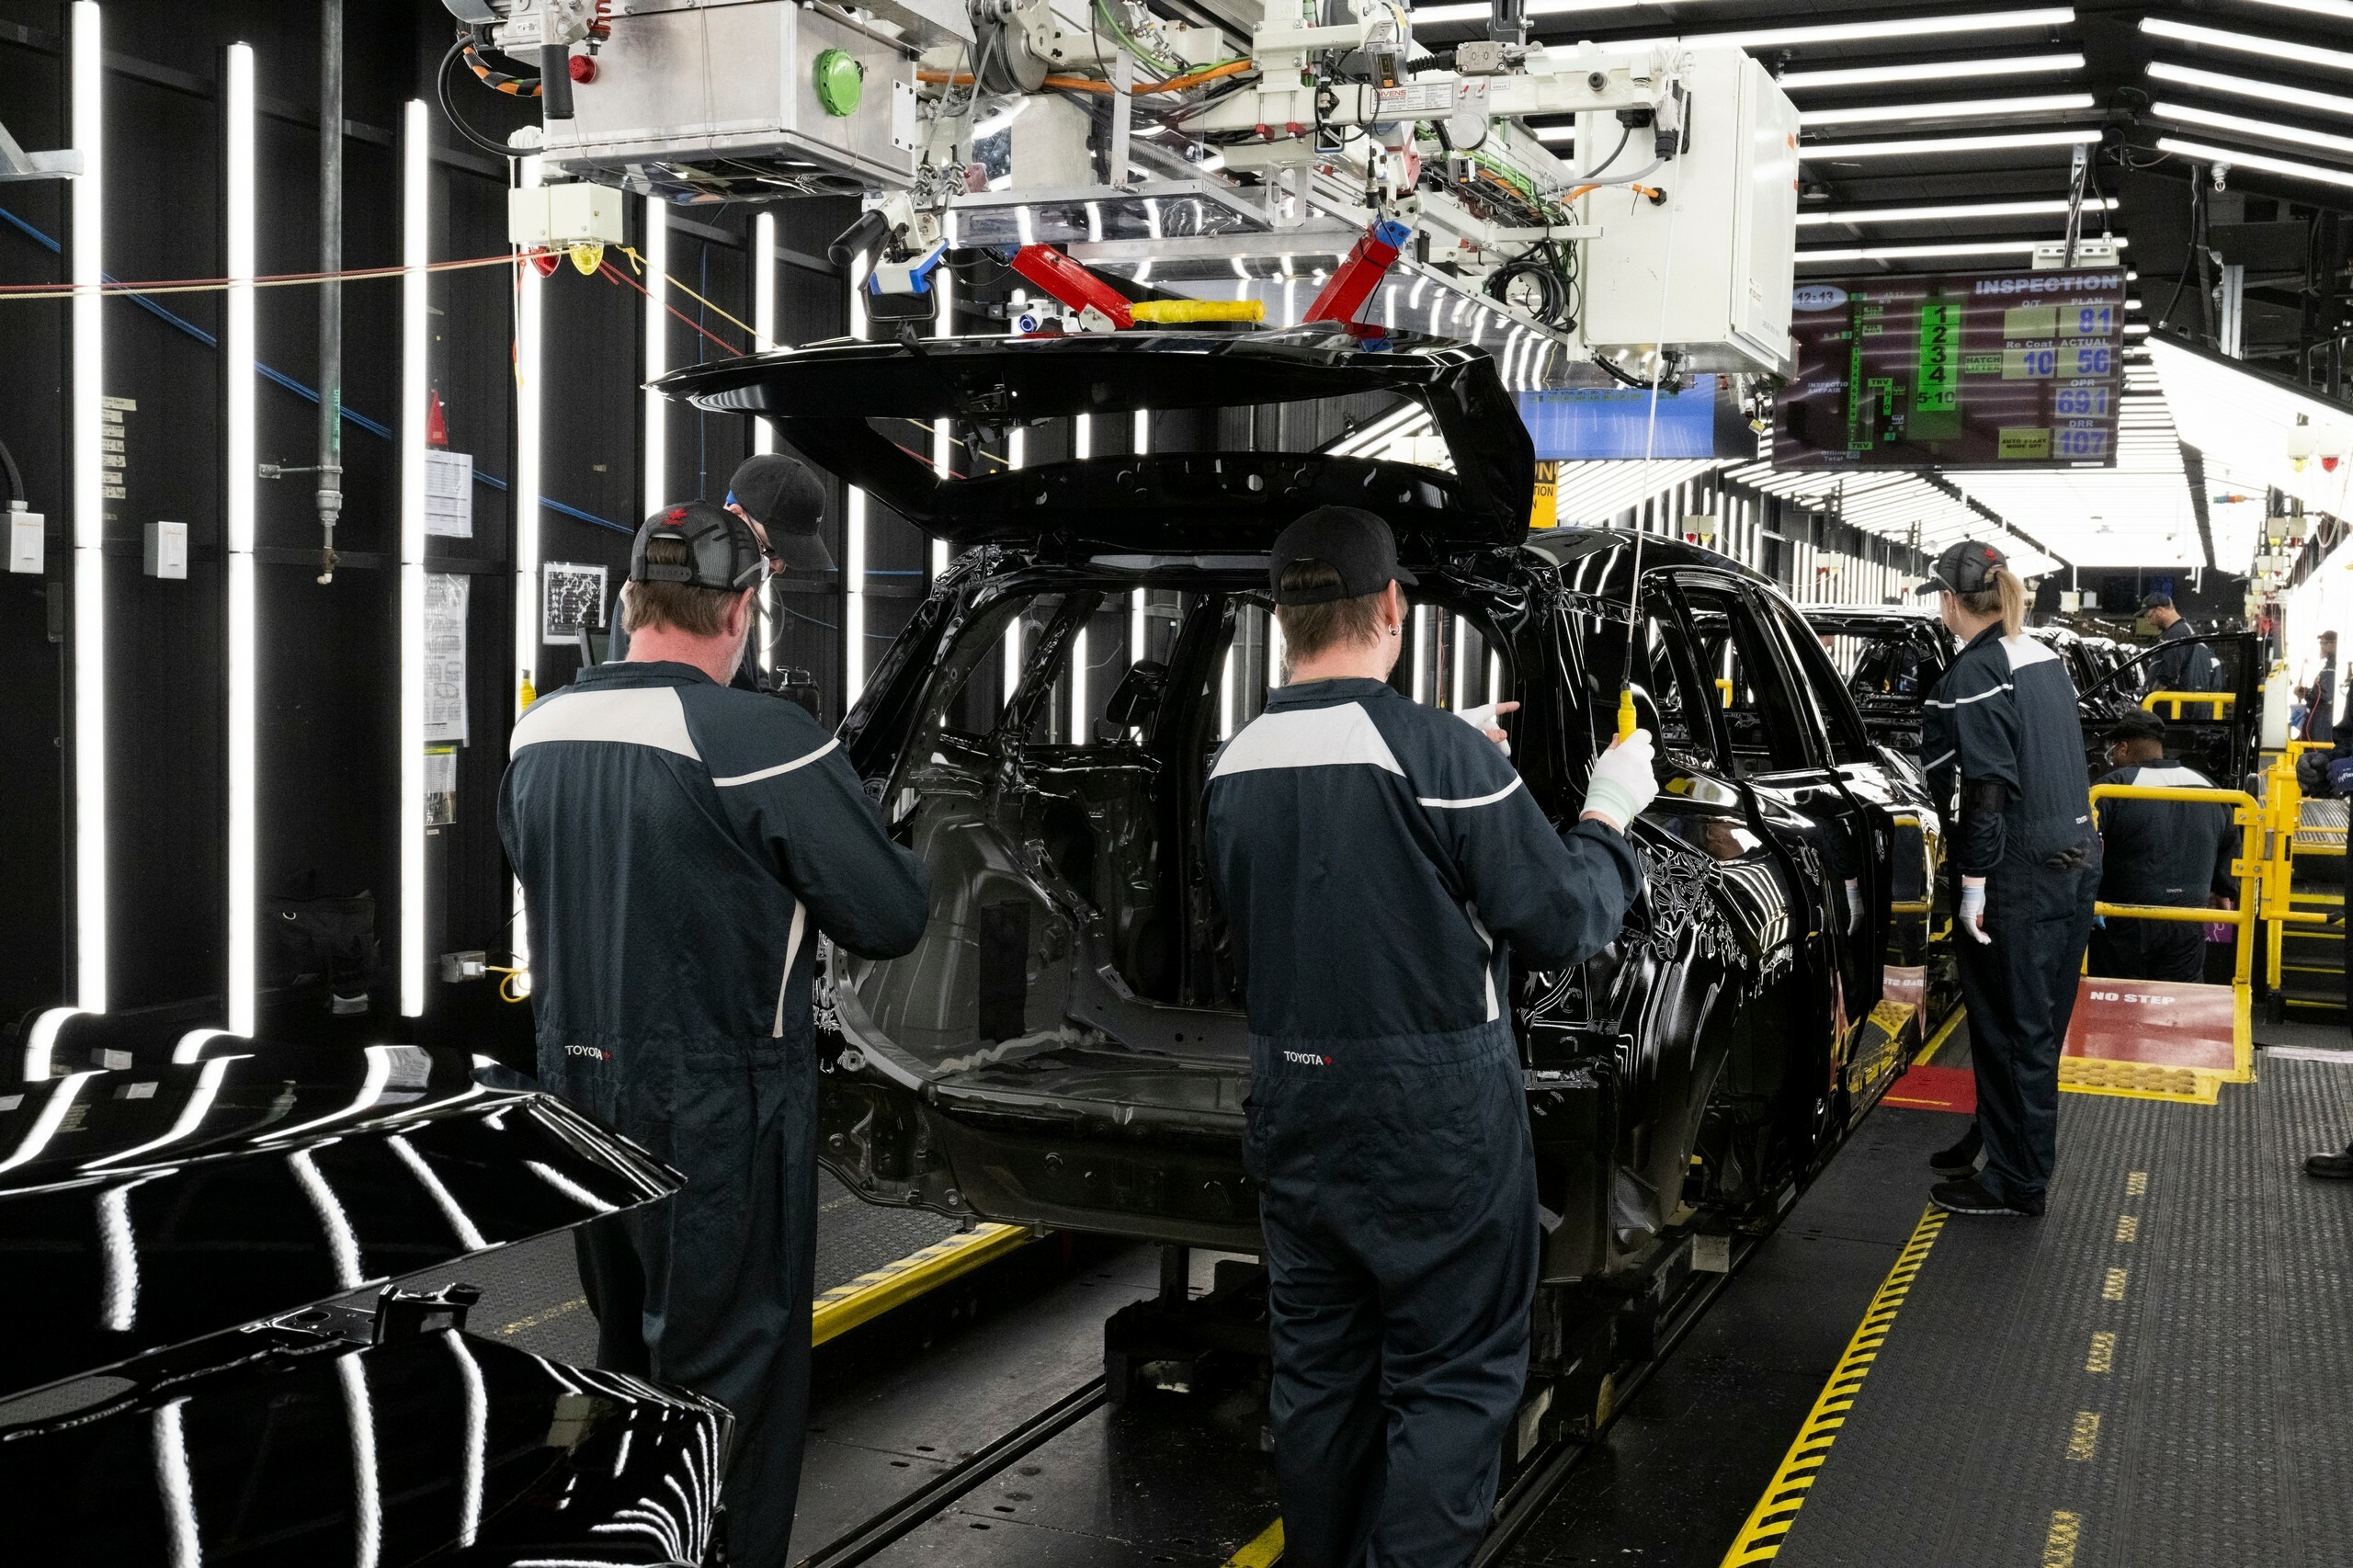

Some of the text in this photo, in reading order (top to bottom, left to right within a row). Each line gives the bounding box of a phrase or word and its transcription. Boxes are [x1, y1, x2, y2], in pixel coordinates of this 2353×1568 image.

[1976, 275, 2118, 295] INSPECTION
[2022, 300, 2041, 308] O/T
[2071, 297, 2103, 305] PLAN
[1934, 306, 1947, 323] 1
[2079, 308, 2110, 333] 81
[1932, 326, 1947, 343] 2
[2060, 338, 2109, 347] ACTUAL
[2026, 340, 2052, 348] Coat
[1930, 347, 1946, 363] 3
[2024, 350, 2053, 376] 10
[2076, 348, 2109, 374] 56
[1928, 366, 1946, 383] 4
[2071, 379, 2095, 387] OPR
[1917, 392, 1955, 403] 5-10
[2060, 430, 2107, 454] 107
[2090, 991, 2176, 1005] NO STEP
[564, 1045, 603, 1061] TOYOTA
[1283, 1051, 1324, 1065] TOYOTA
